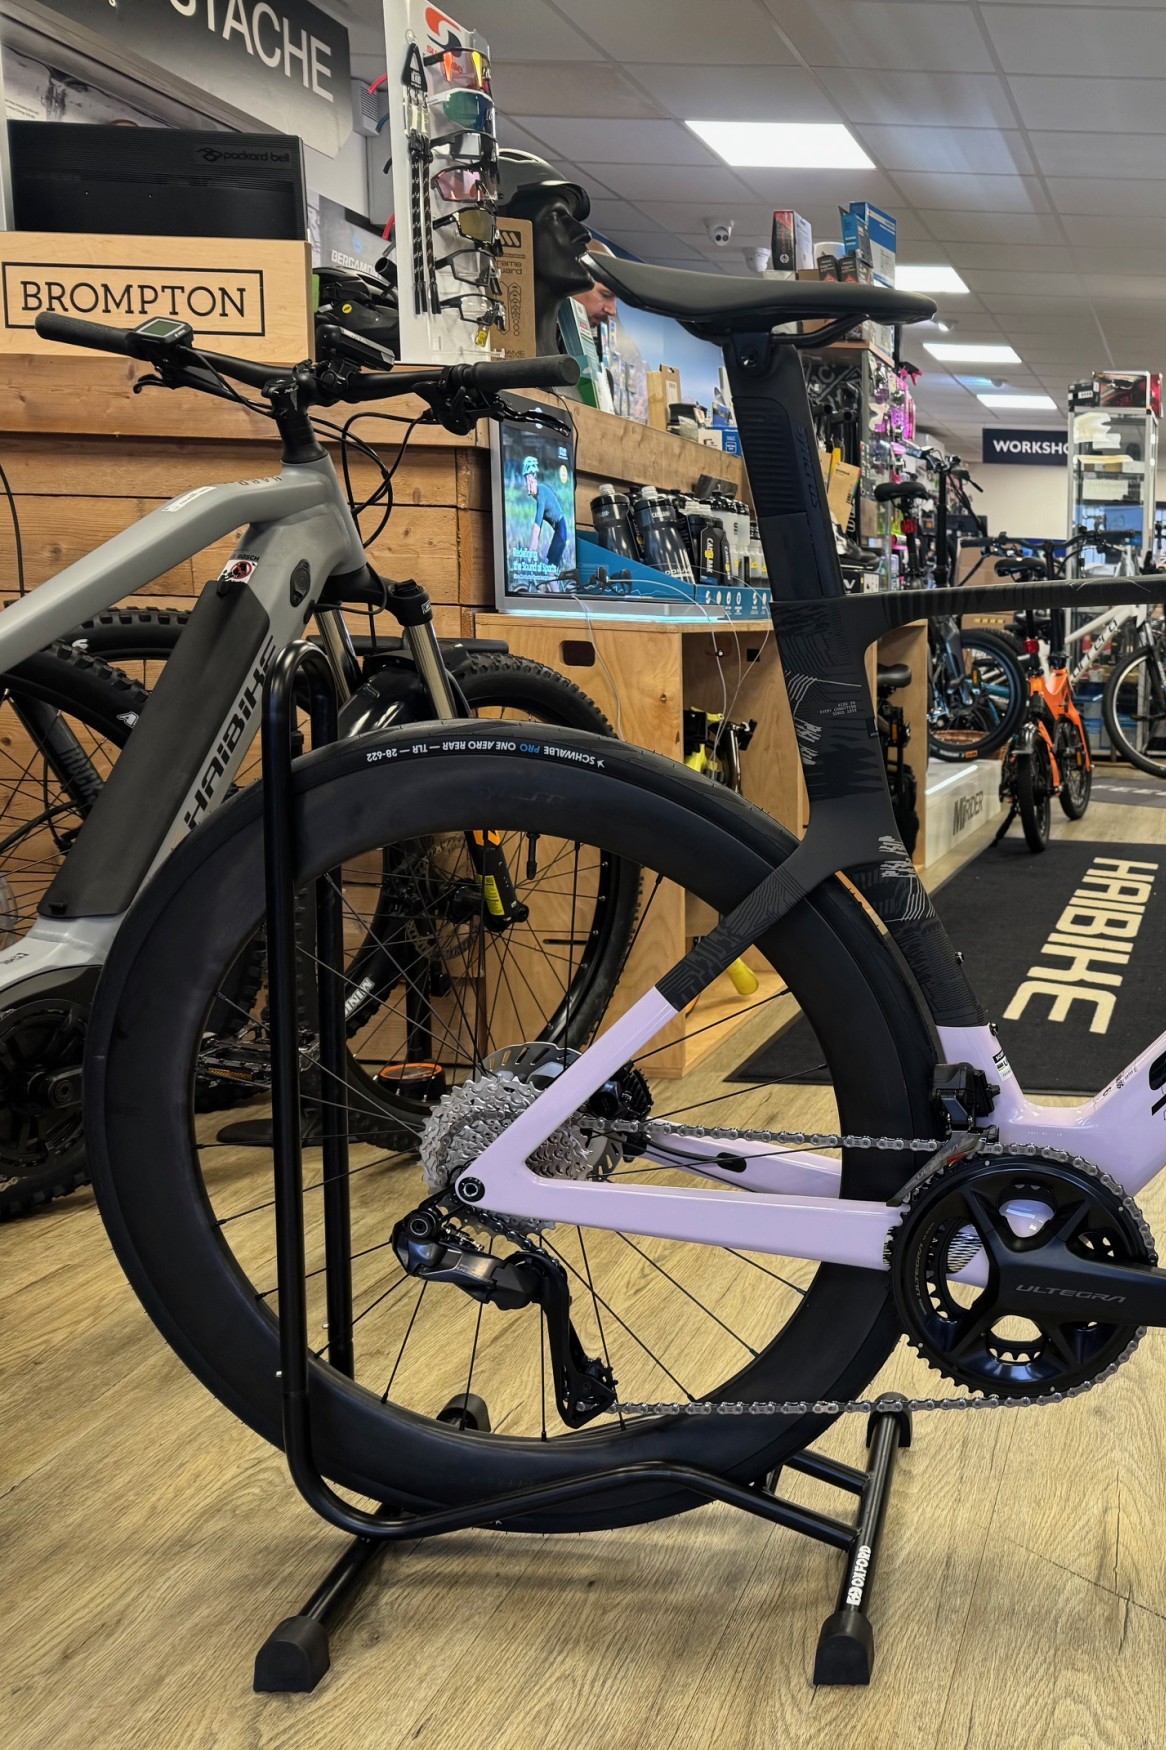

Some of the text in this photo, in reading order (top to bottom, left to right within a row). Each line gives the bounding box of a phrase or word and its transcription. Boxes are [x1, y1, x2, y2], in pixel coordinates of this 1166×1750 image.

[223, 151, 290, 163] packard bell
[20, 280, 247, 318] BROMPTON
[1072, 619, 1118, 678] arrera
[366, 740, 596, 766] SCHWALBE PRO ONE AERO REAR TLR 28-622
[1002, 856, 1159, 1035] HAIBIKE
[914, 1243, 924, 1297] ULTEGRA
[1015, 1283, 1128, 1304] ULTEGRA
[851, 1545, 872, 1588] OXFORD
